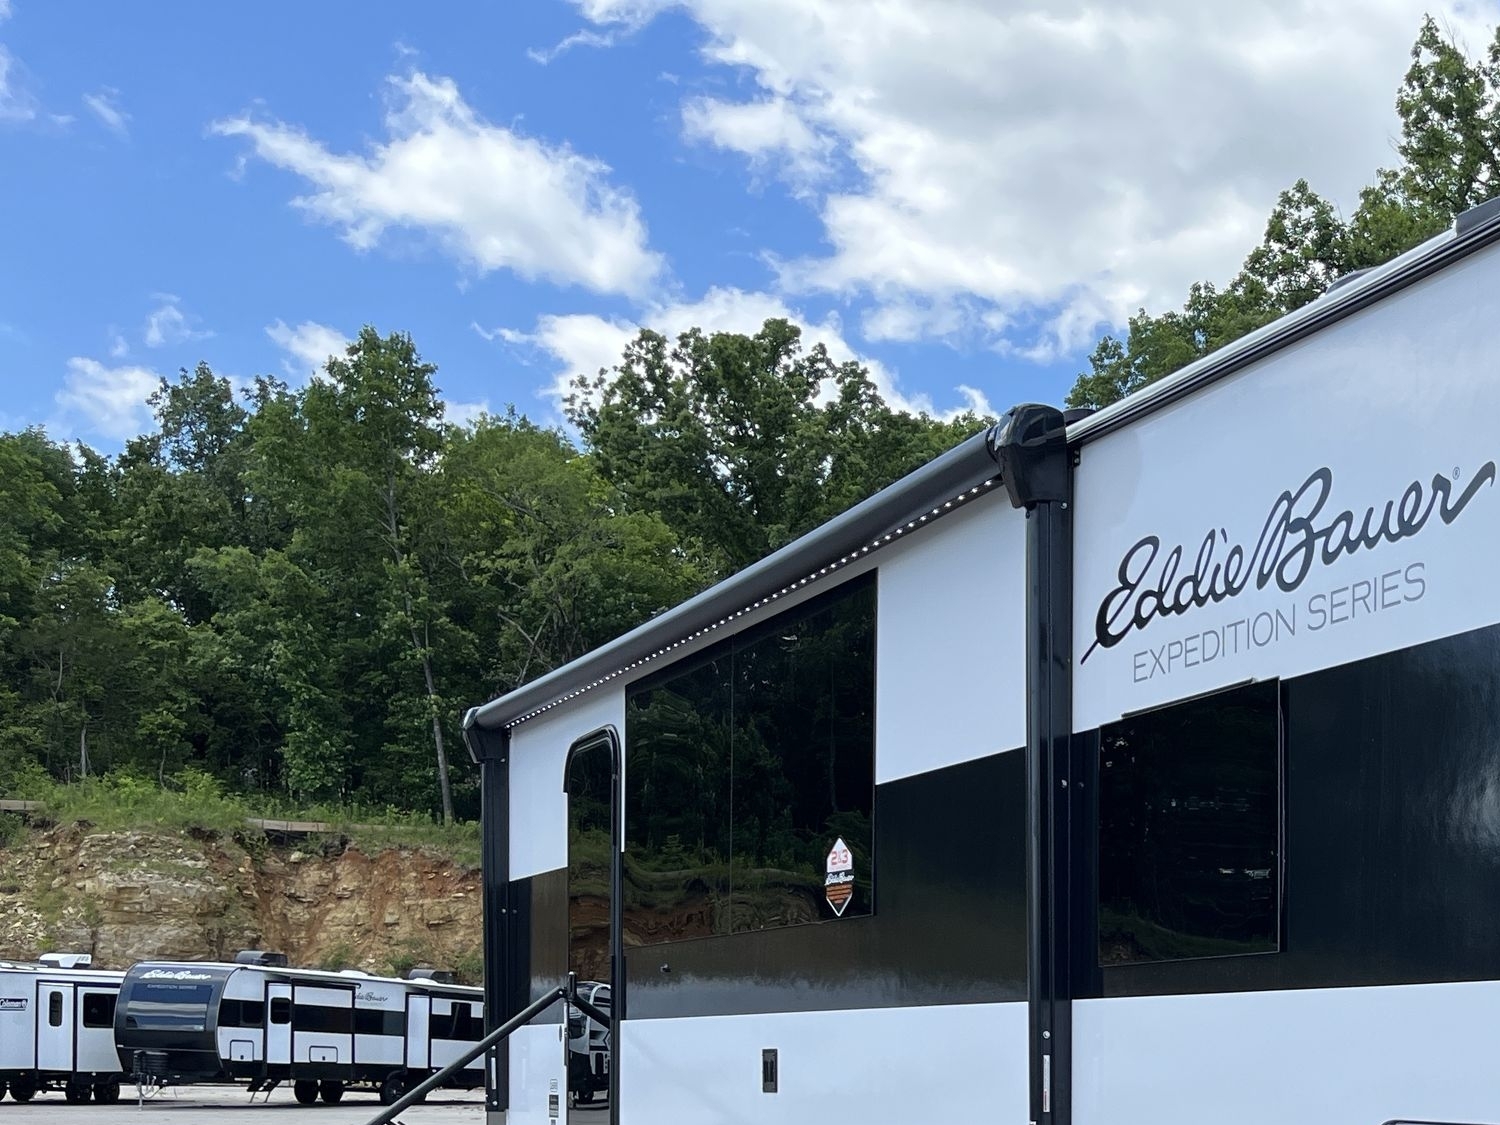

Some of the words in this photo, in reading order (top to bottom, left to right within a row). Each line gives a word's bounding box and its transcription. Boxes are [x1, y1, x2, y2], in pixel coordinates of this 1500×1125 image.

[1080, 528, 1262, 665] Eddie
[1256, 461, 1496, 593] Bauer
[1132, 603, 1297, 684] EXPEDITION
[1306, 562, 1427, 631] SERIES
